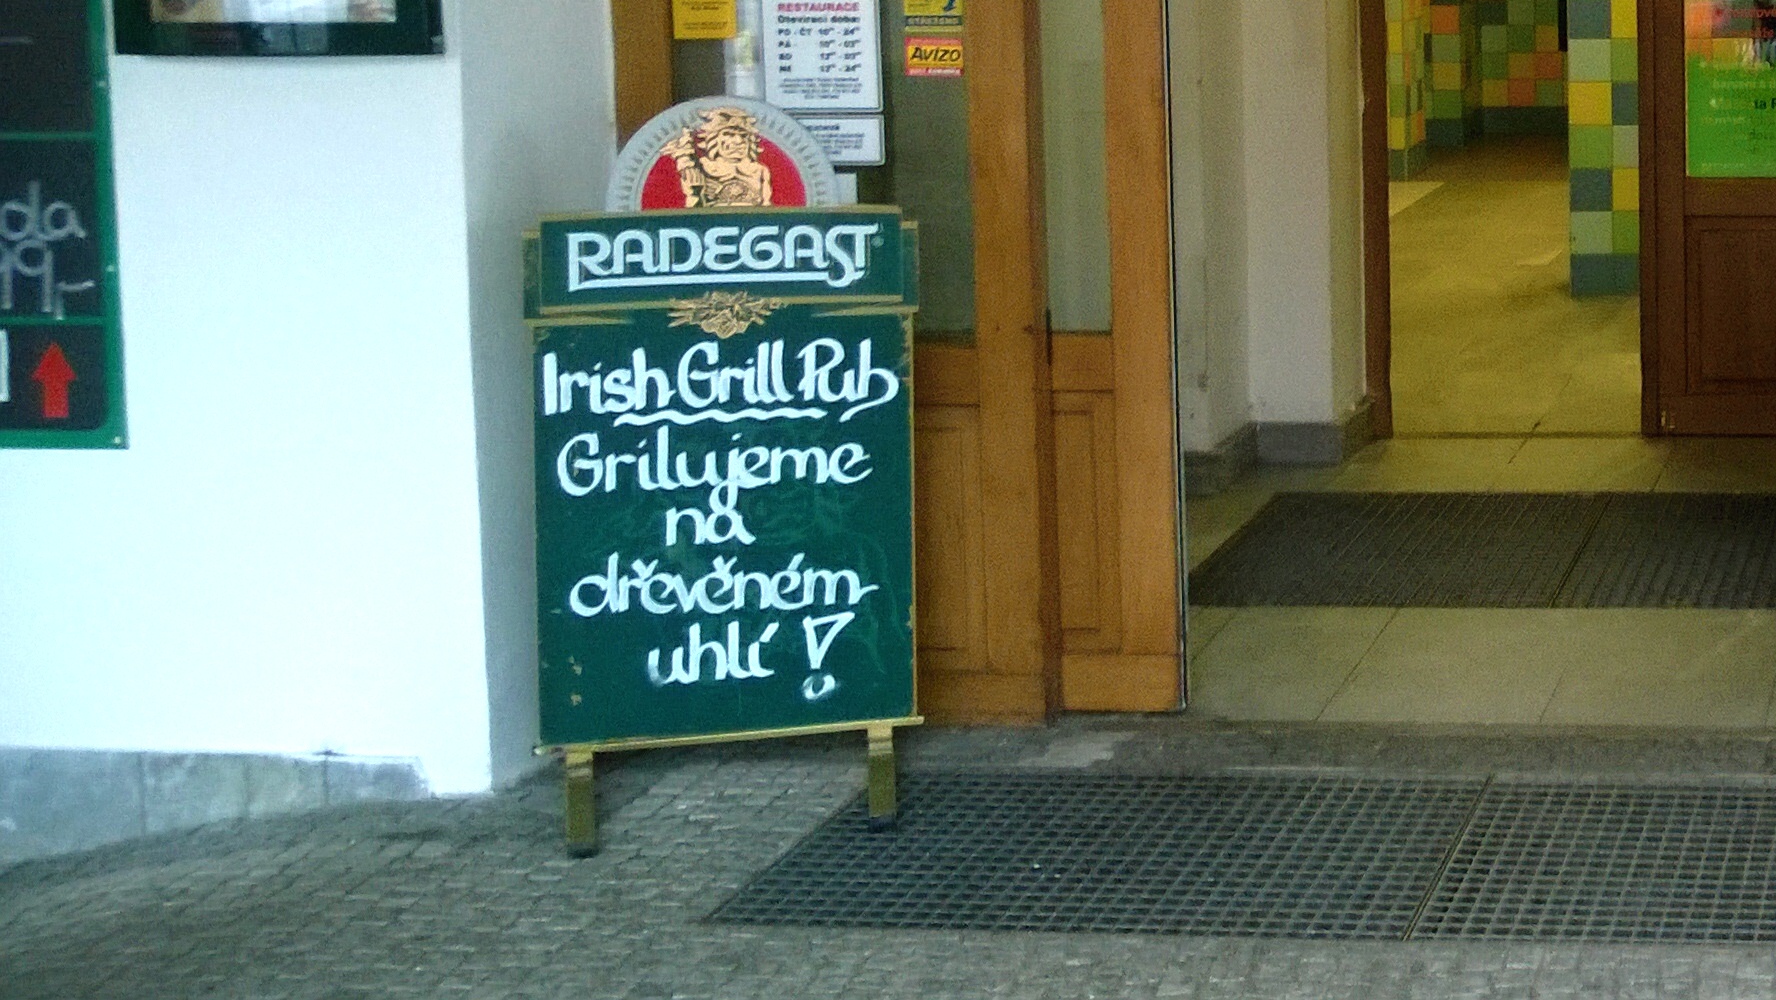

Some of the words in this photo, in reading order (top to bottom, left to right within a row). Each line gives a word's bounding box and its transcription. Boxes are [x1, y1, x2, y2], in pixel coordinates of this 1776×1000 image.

[778, 2, 860, 12] RESTAURACE
[566, 222, 879, 291] RADEGAST
[542, 346, 673, 417] Irish
[676, 336, 793, 408] Grill
[798, 337, 899, 422] Pub
[557, 425, 873, 510] Grilujeme
[665, 507, 756, 548] na
[569, 552, 879, 619] dřevěném
[647, 620, 779, 686] uhlí
